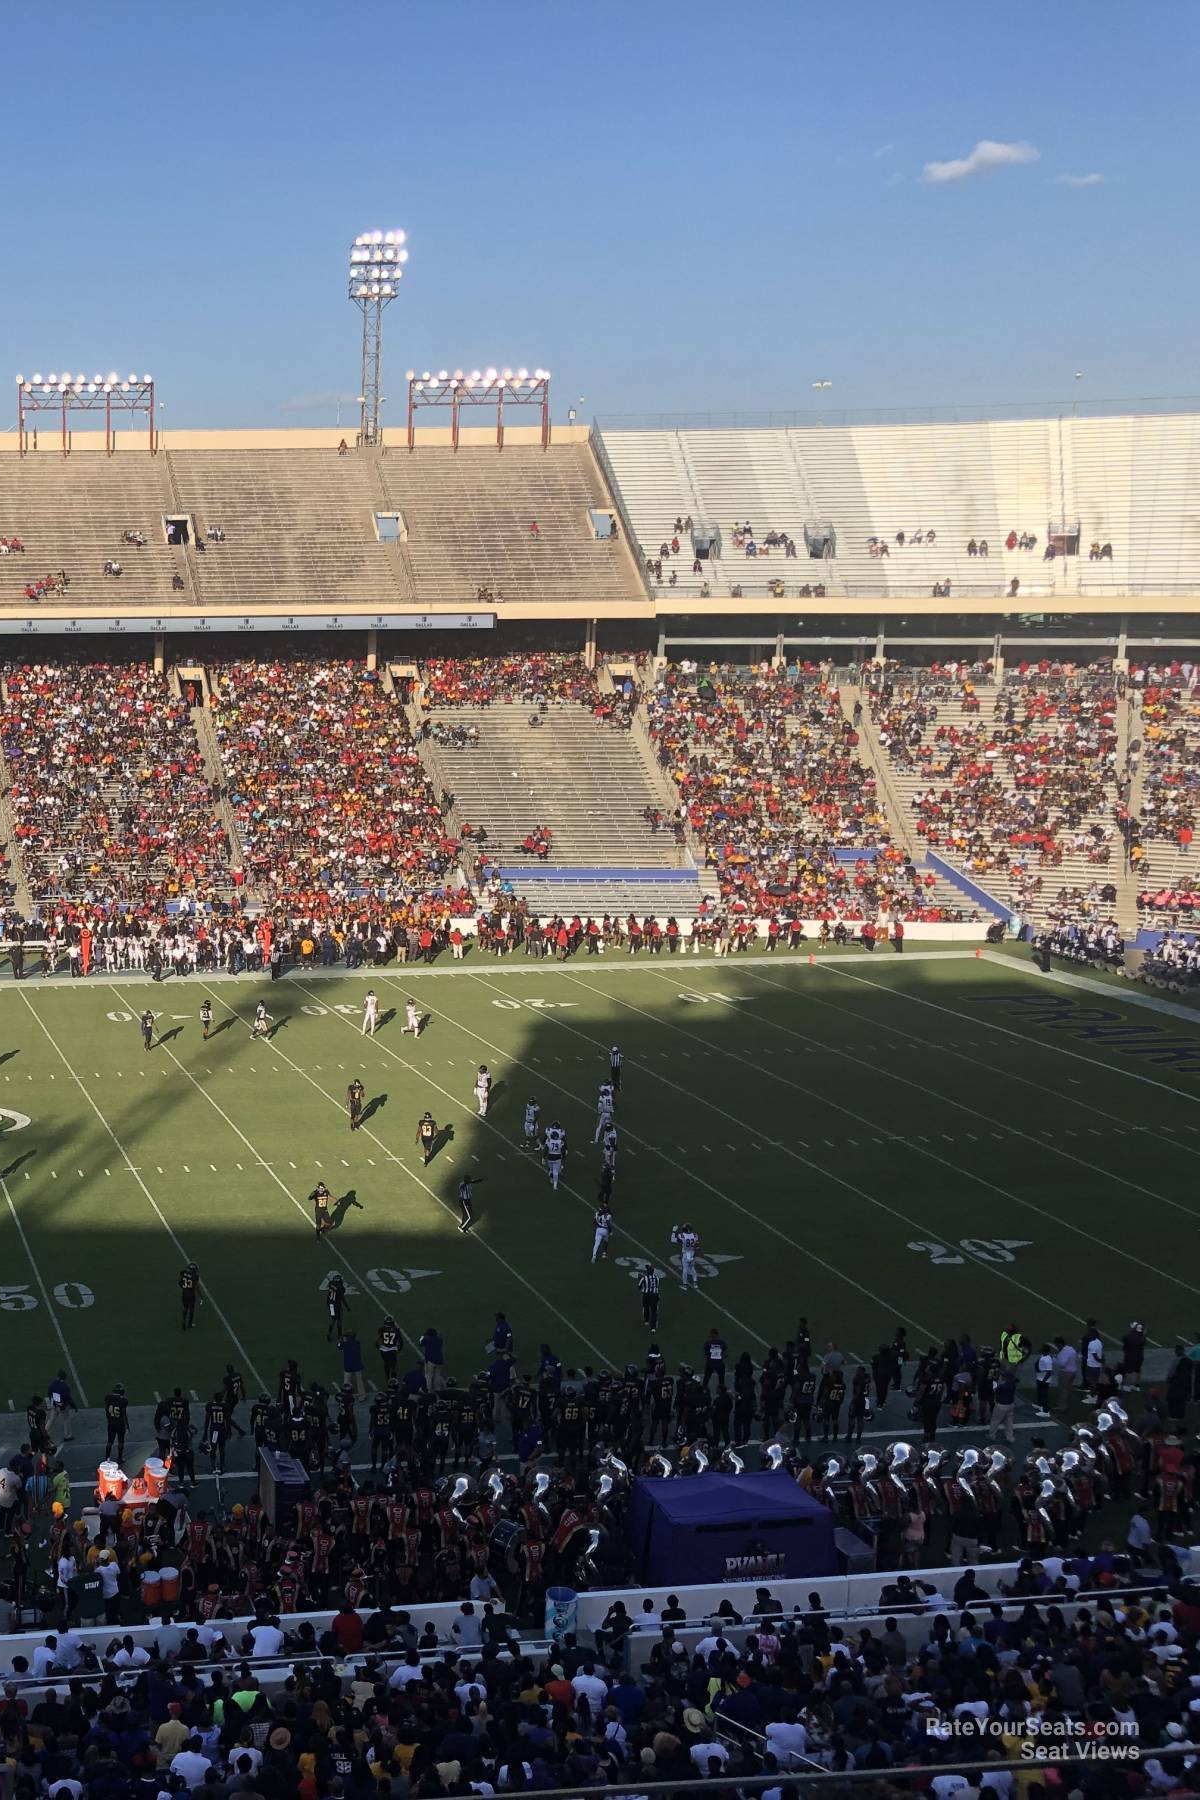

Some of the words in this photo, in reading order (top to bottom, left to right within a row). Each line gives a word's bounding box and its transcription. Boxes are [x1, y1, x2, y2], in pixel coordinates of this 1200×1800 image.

[906, 1239, 1016, 1264] 20
[383, 1332, 396, 1345] 57
[565, 1407, 579, 1420] 66
